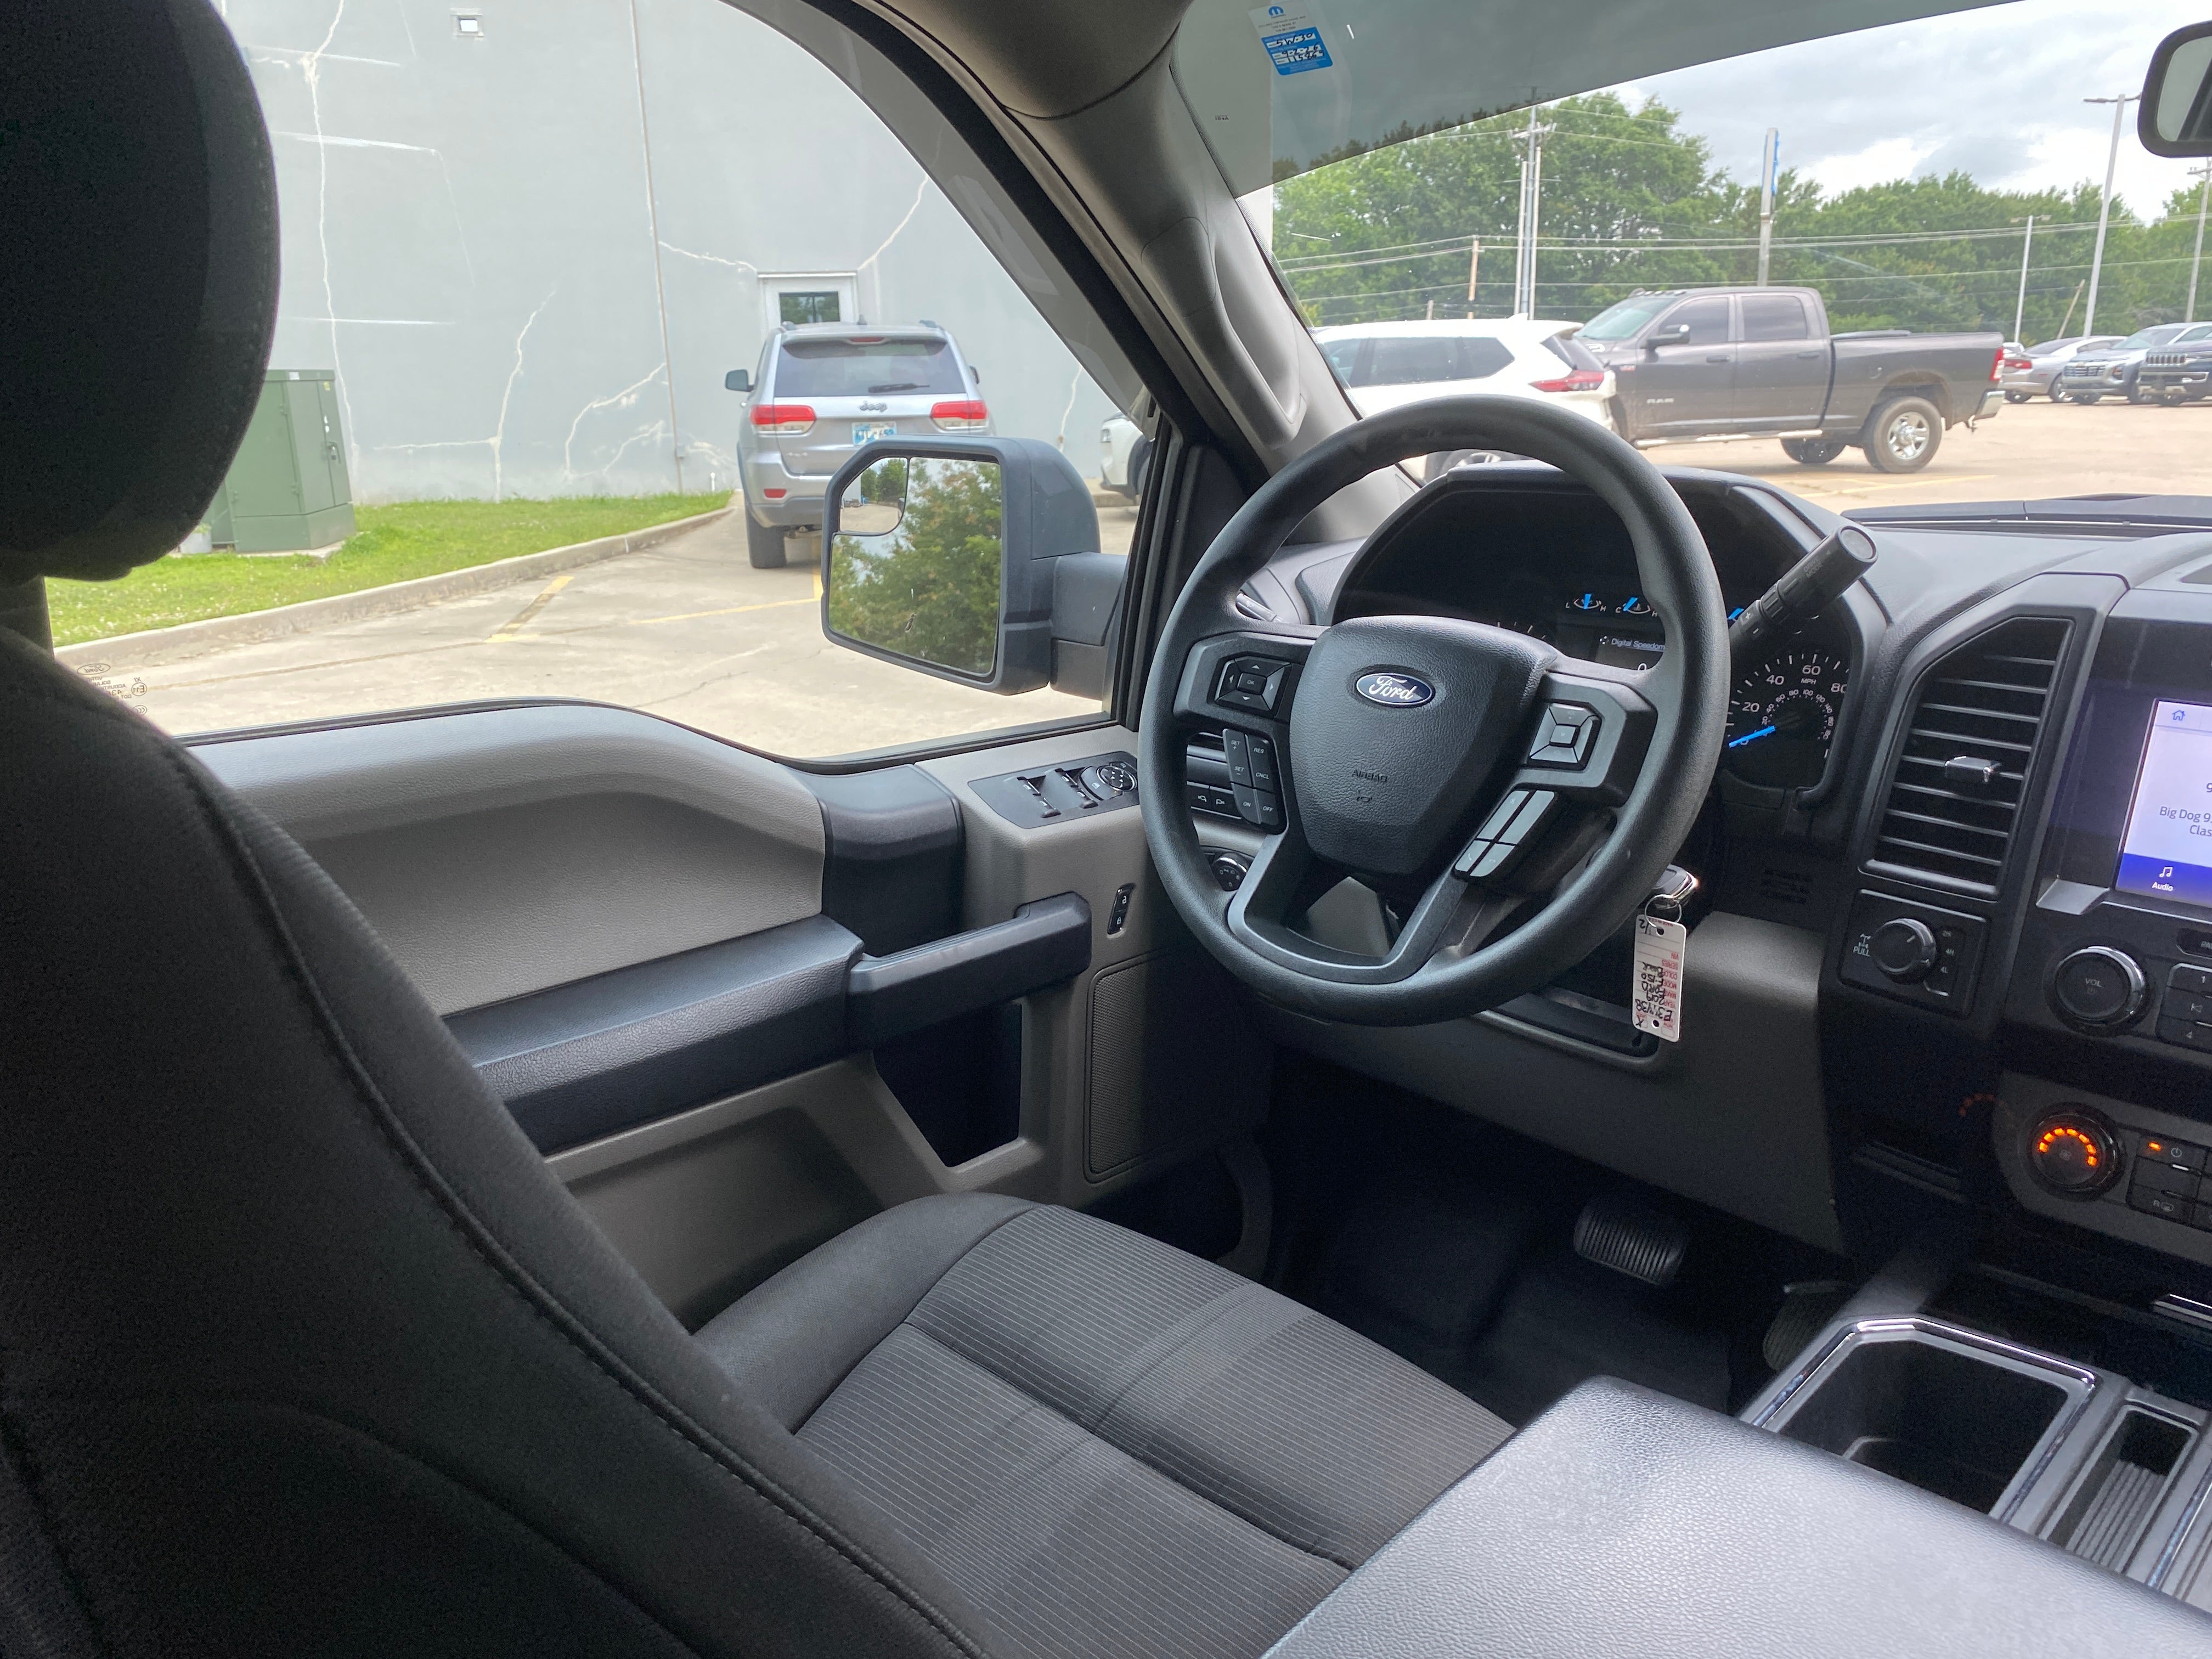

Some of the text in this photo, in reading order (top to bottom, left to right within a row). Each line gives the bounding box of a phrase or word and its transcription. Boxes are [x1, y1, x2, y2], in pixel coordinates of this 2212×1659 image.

[859, 400, 888, 413] Jeep
[1611, 638, 1632, 647] Digital
[1802, 664, 1821, 675] 60
[1766, 675, 1784, 685] 40
[1368, 675, 1418, 700] Ford
[1831, 682, 1847, 693] 80
[1775, 693, 1786, 702] 60
[1815, 694, 1825, 703] 120
[1742, 702, 1759, 713] 20
[1766, 703, 1774, 713] 40
[1762, 715, 1768, 725] 20
[2159, 806, 2212, 823] Big Dog 9
[2190, 825, 2212, 837] Clas
[2152, 882, 2174, 891] Audio
[1853, 946, 1870, 957] PULL
[1662, 960, 1678, 970] SERIES
[2085, 978, 2102, 988] VOL
[1641, 981, 1666, 999] FORD
